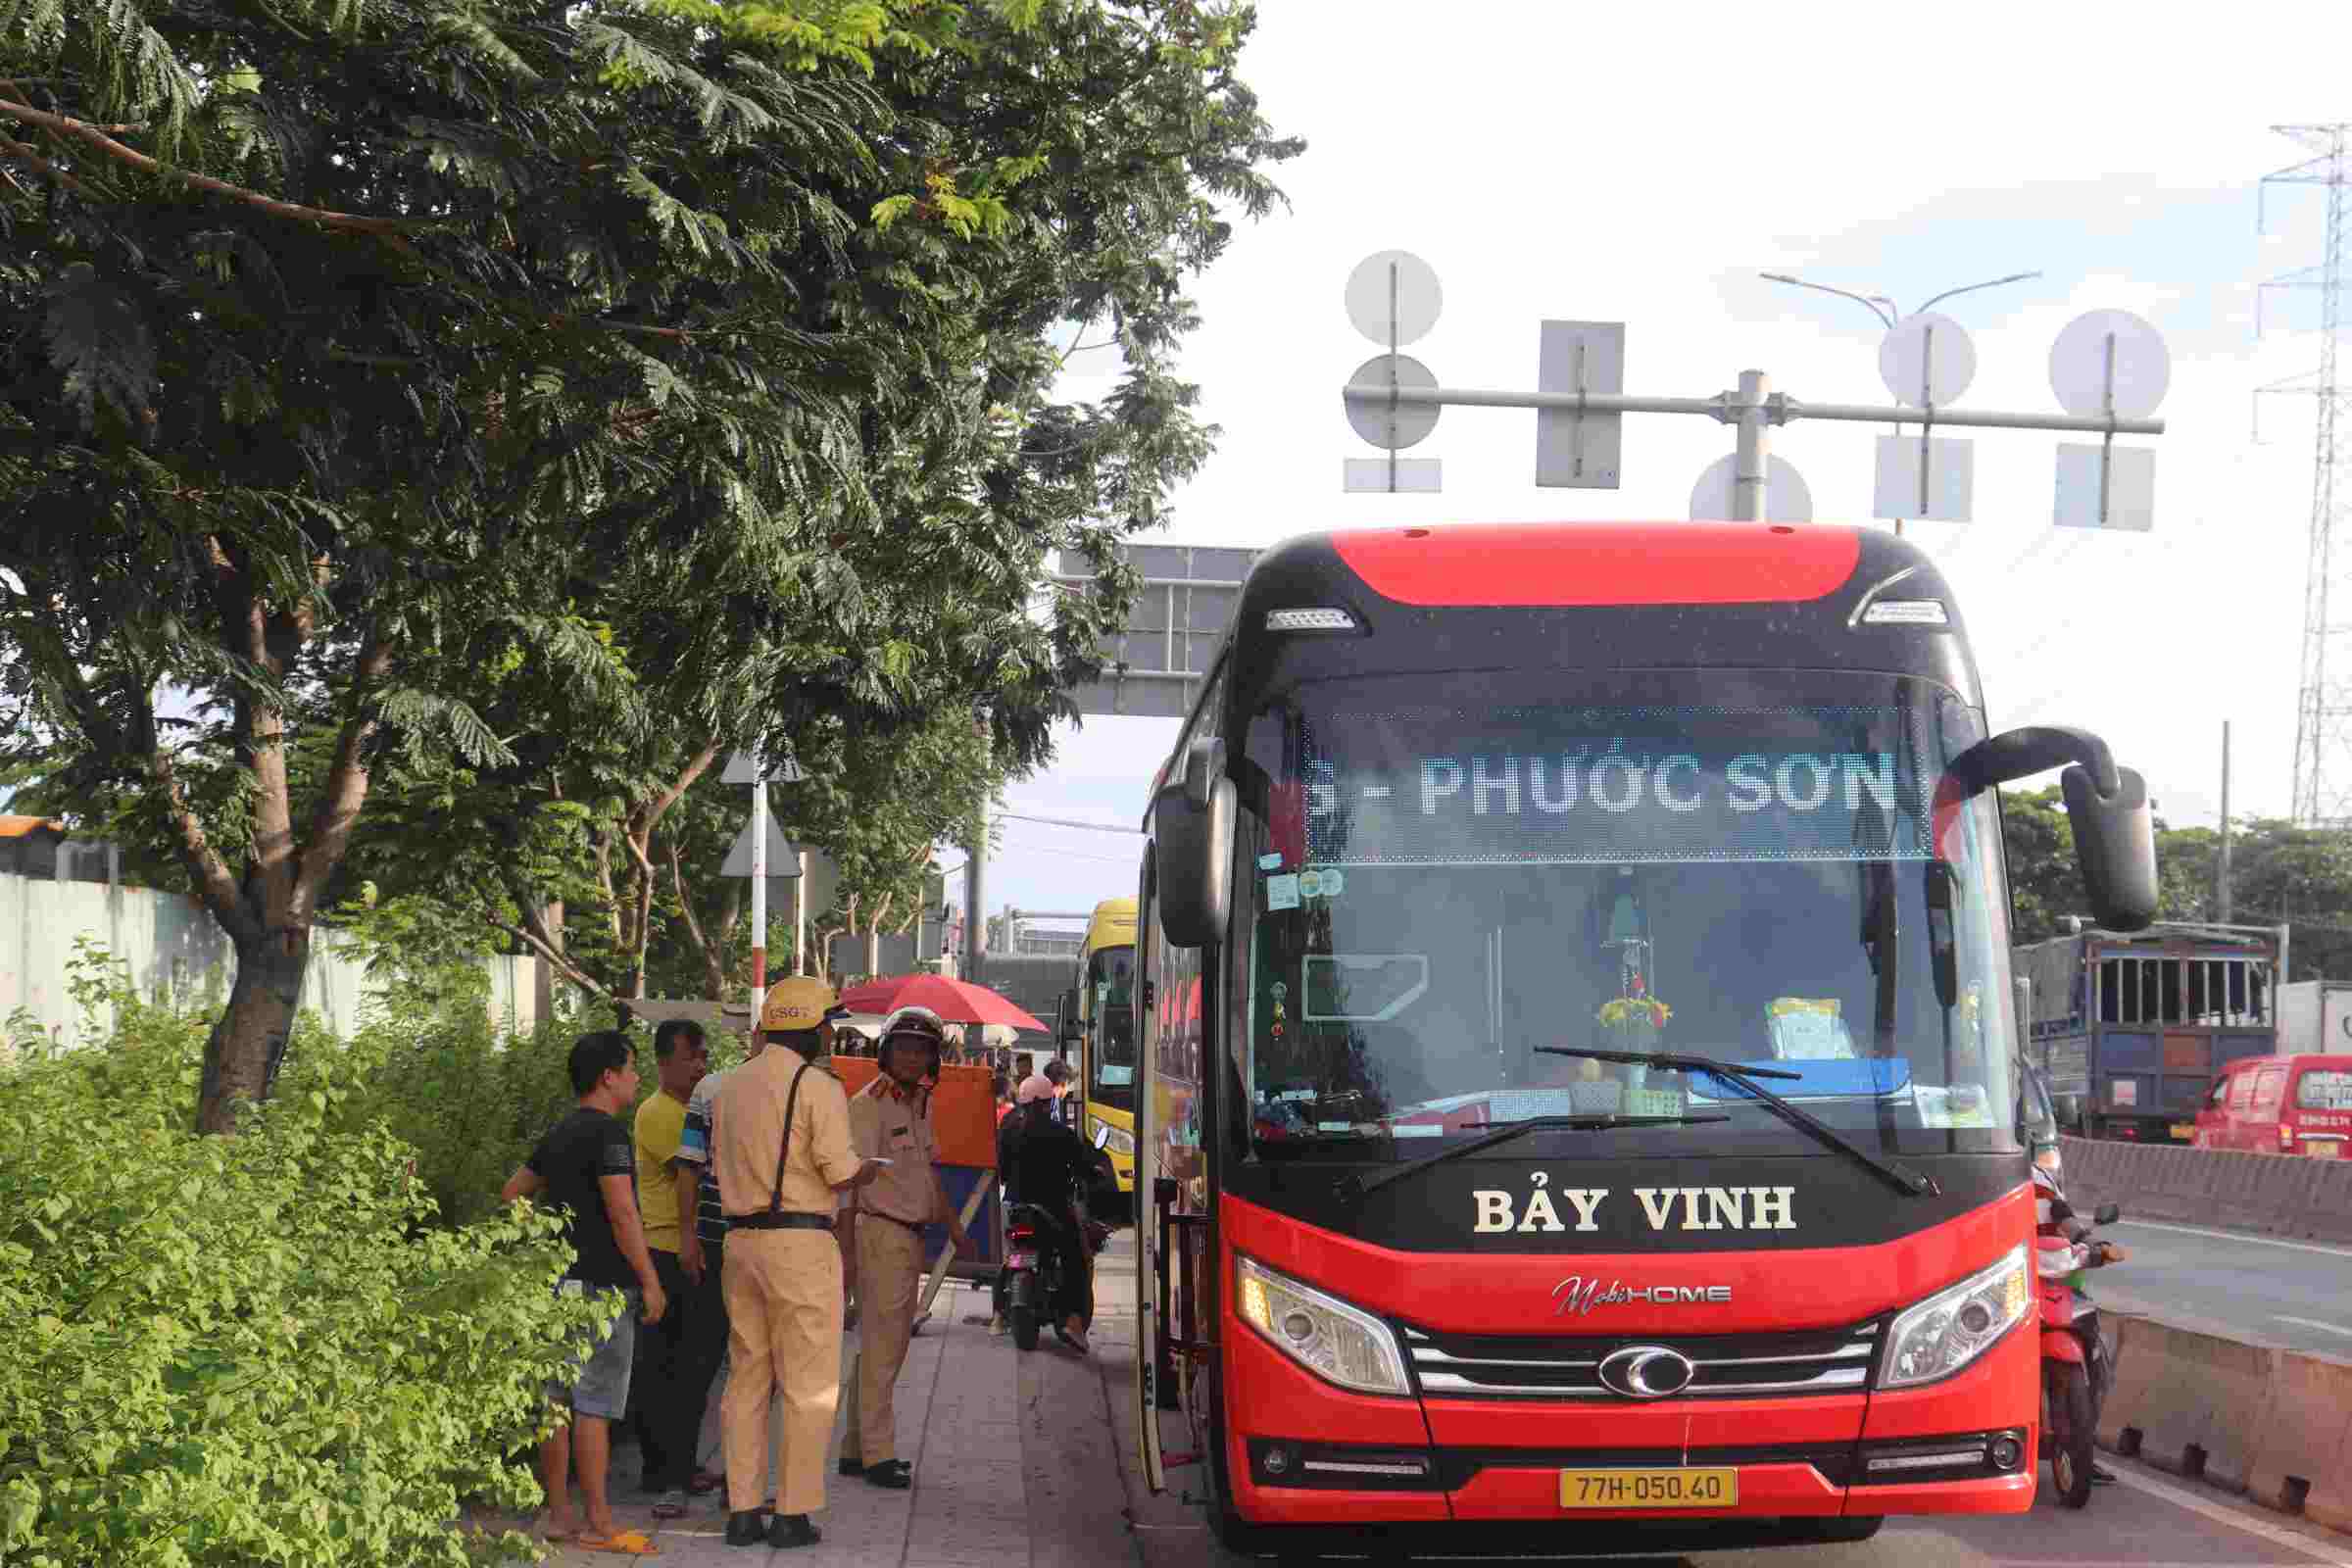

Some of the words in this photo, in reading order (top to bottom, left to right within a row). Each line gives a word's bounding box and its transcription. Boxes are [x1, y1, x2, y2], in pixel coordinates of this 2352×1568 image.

[1419, 736, 1701, 814] PHƯỚC
[1725, 752, 1897, 812] SƠN
[1473, 1171, 1609, 1233] BẢY
[1634, 1186, 1797, 1231] VINH
[1576, 1476, 1721, 1500] 77H-050.40
